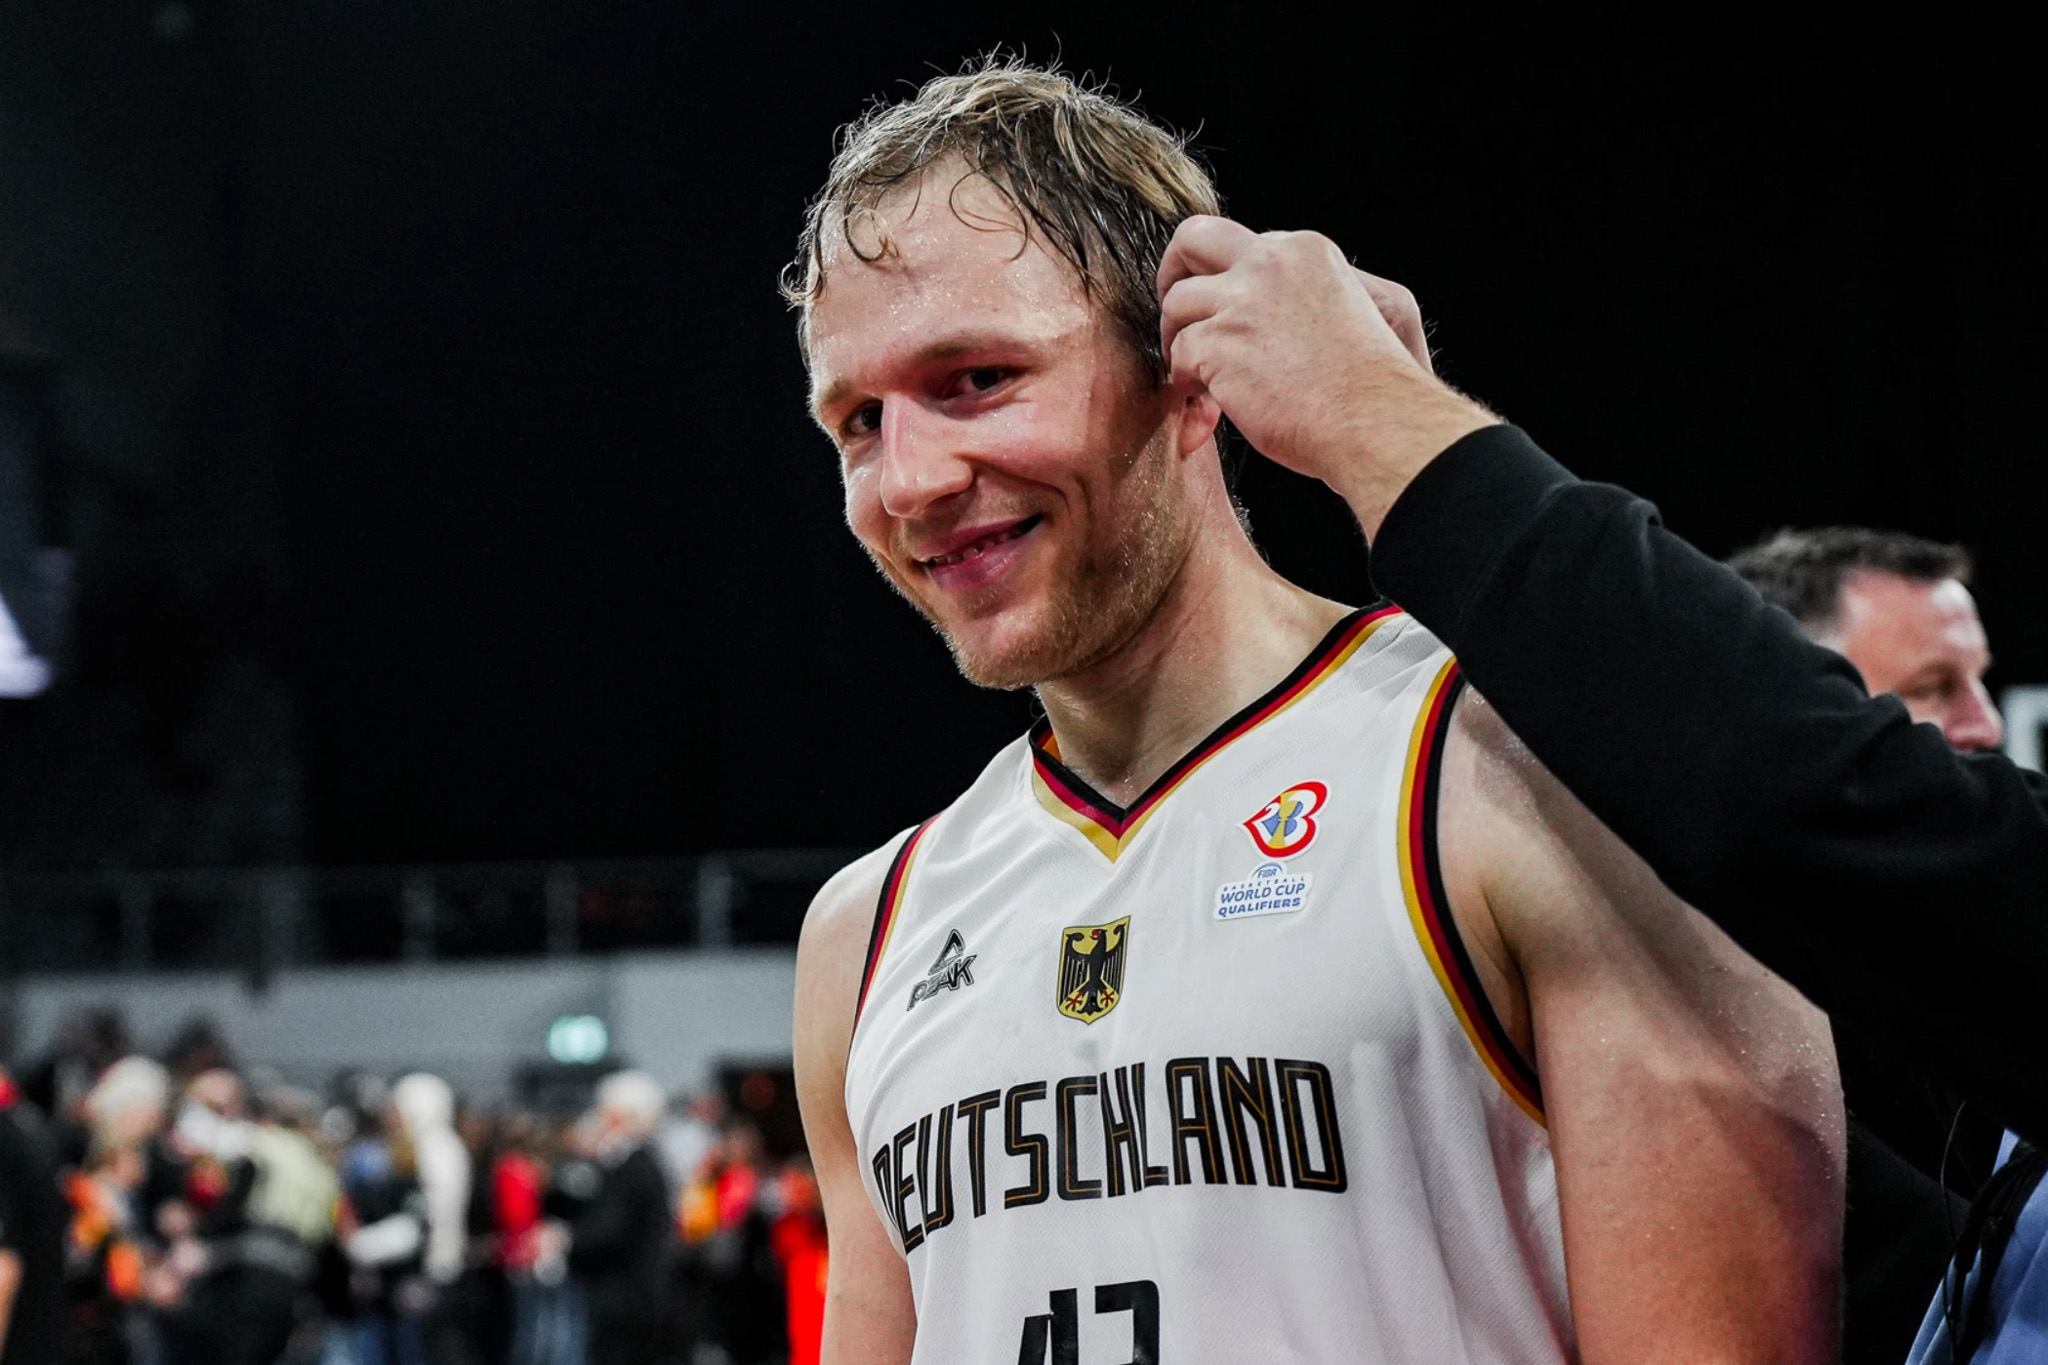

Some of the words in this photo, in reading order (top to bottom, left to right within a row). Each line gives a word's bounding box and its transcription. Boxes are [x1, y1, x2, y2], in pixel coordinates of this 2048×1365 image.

[1223, 876, 1305, 891] BASKETBALL
[1257, 868, 1277, 879] FIBA
[1221, 886, 1272, 904] WORLD
[1275, 883, 1306, 896] CUP
[1218, 897, 1301, 917] QUALIFIERS
[907, 954, 977, 1011] PEAK
[872, 1056, 1347, 1255] DEUTSCHLAND
